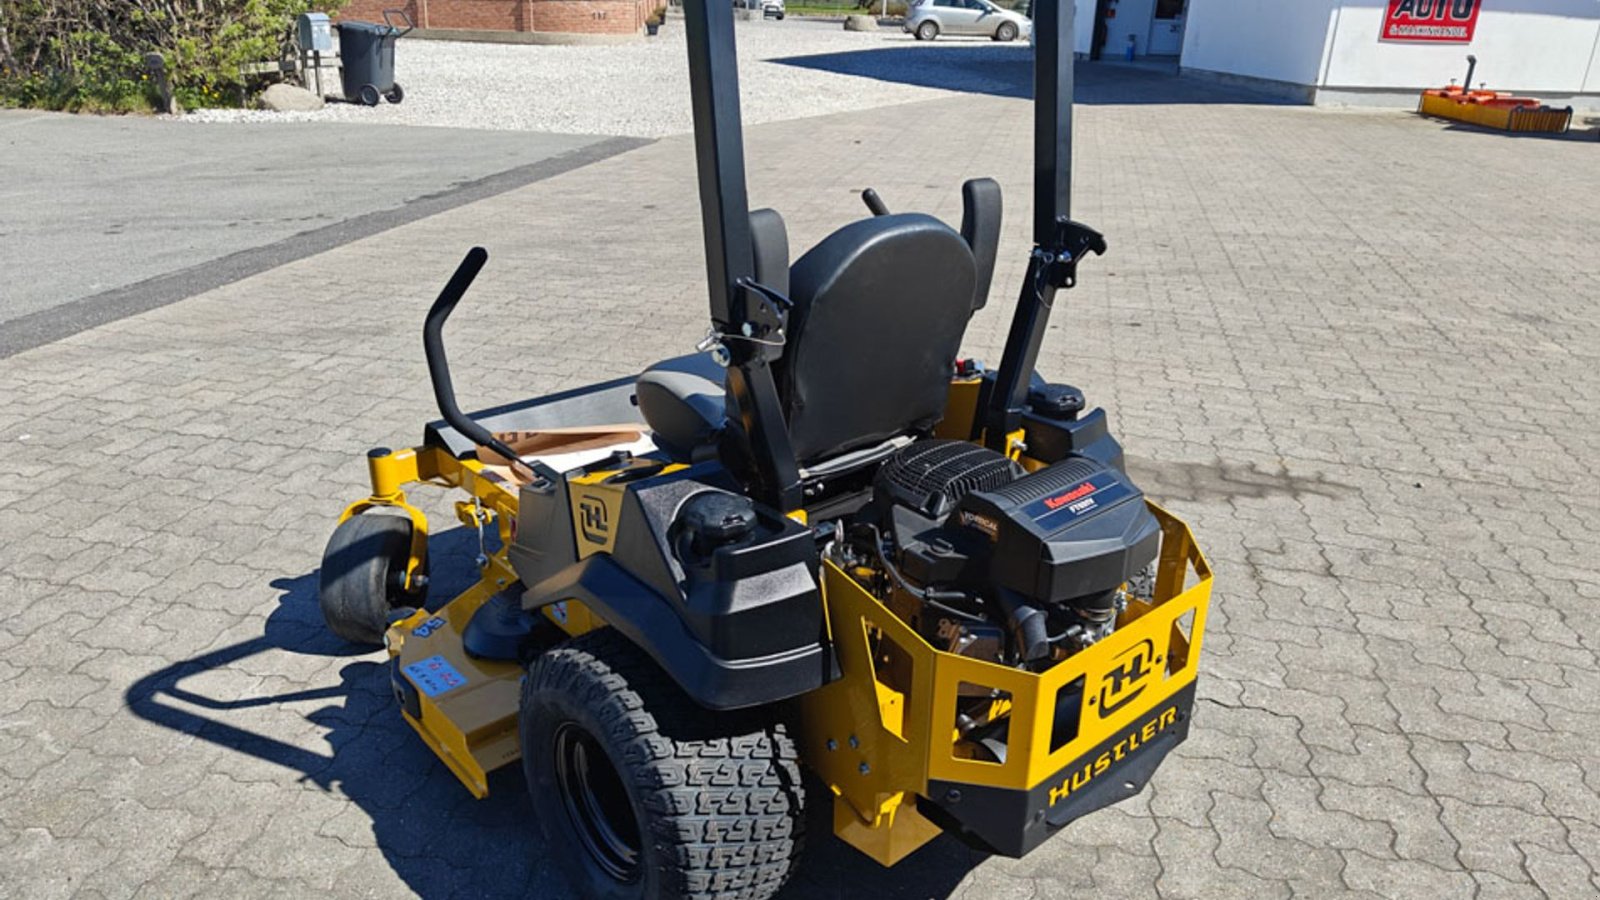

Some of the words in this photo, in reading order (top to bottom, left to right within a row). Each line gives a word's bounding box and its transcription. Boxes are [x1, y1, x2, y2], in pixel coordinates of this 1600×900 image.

[1390, 24, 1398, 35] &
[1043, 482, 1097, 509] Kawasaki
[1049, 706, 1178, 808] HUSTLER
